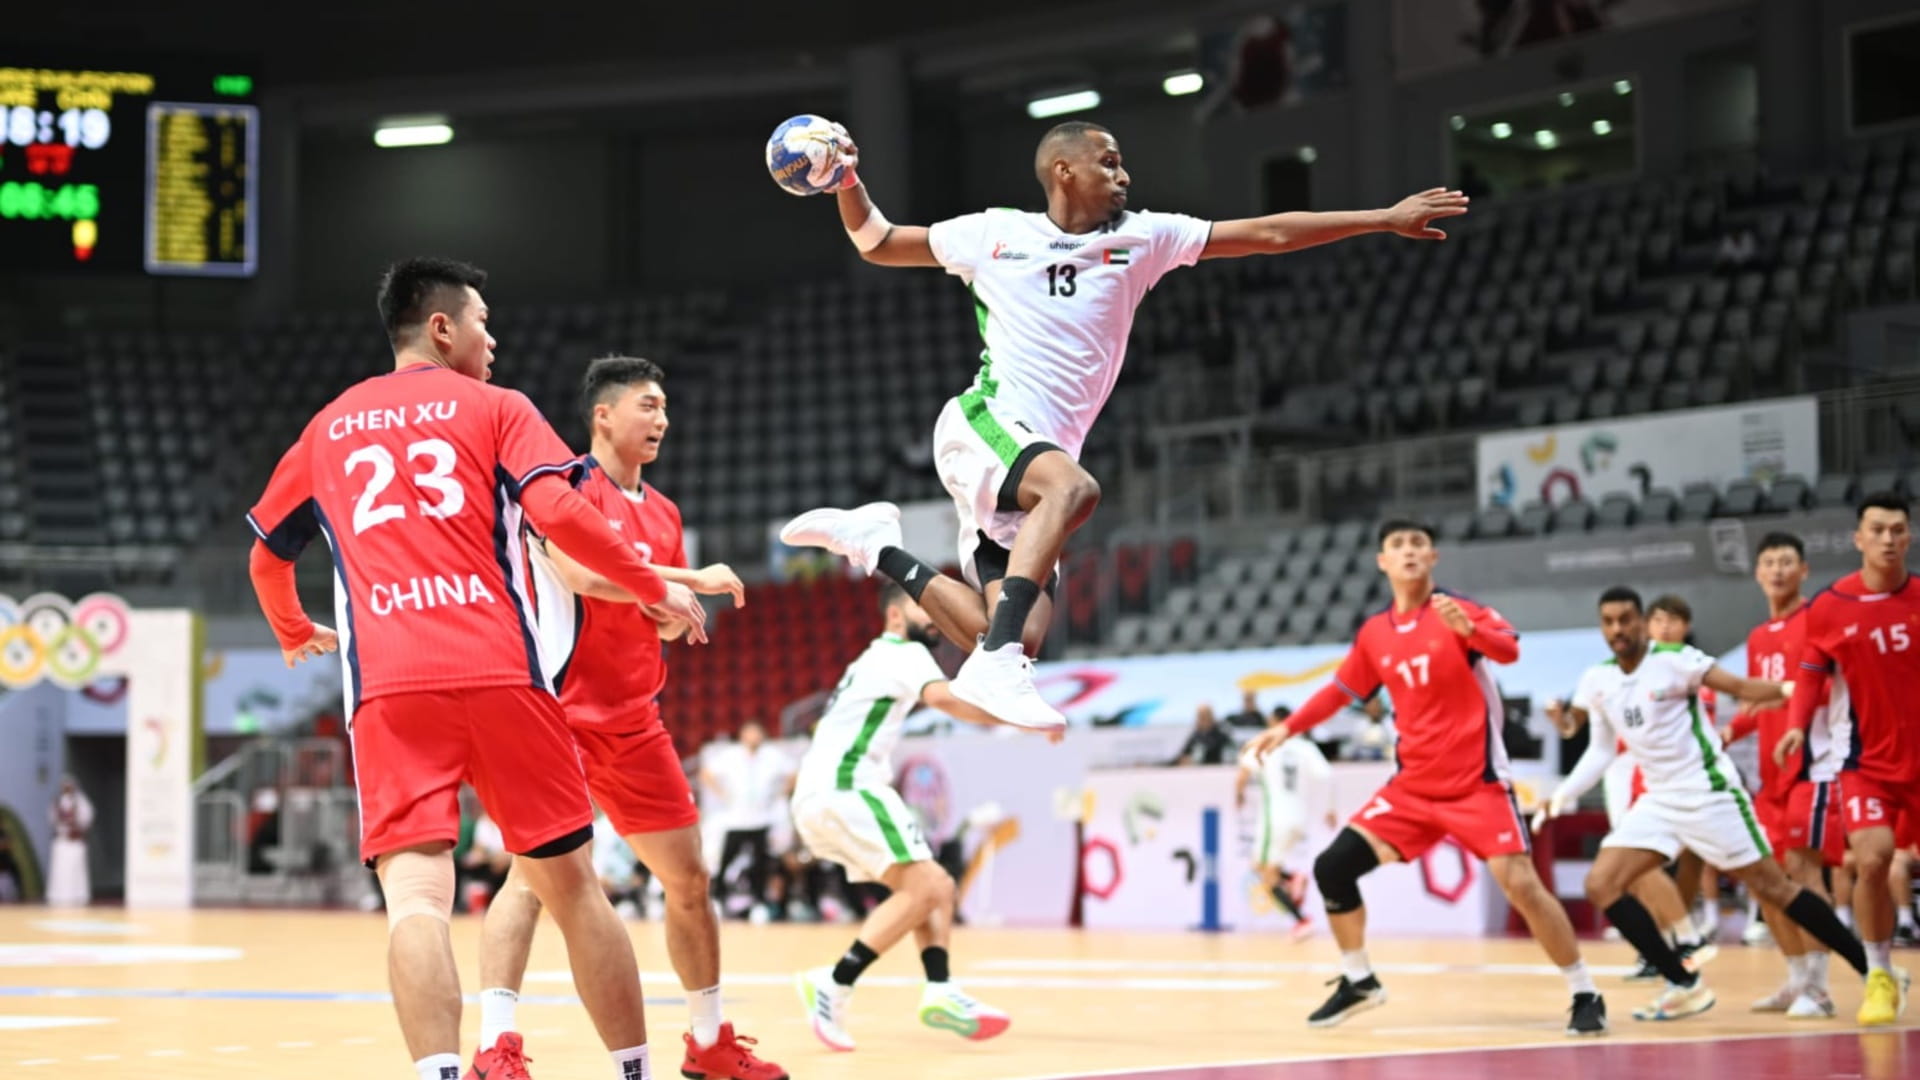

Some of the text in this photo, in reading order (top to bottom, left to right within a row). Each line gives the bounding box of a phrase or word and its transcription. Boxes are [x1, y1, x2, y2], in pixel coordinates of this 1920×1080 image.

[1046, 263, 1077, 297] 13
[329, 400, 457, 441] CHEN XU
[344, 438, 465, 536] 23
[371, 573, 495, 615] CHINA
[1869, 623, 1910, 654] 15
[1396, 654, 1429, 688] 17
[1847, 796, 1883, 822] 15
